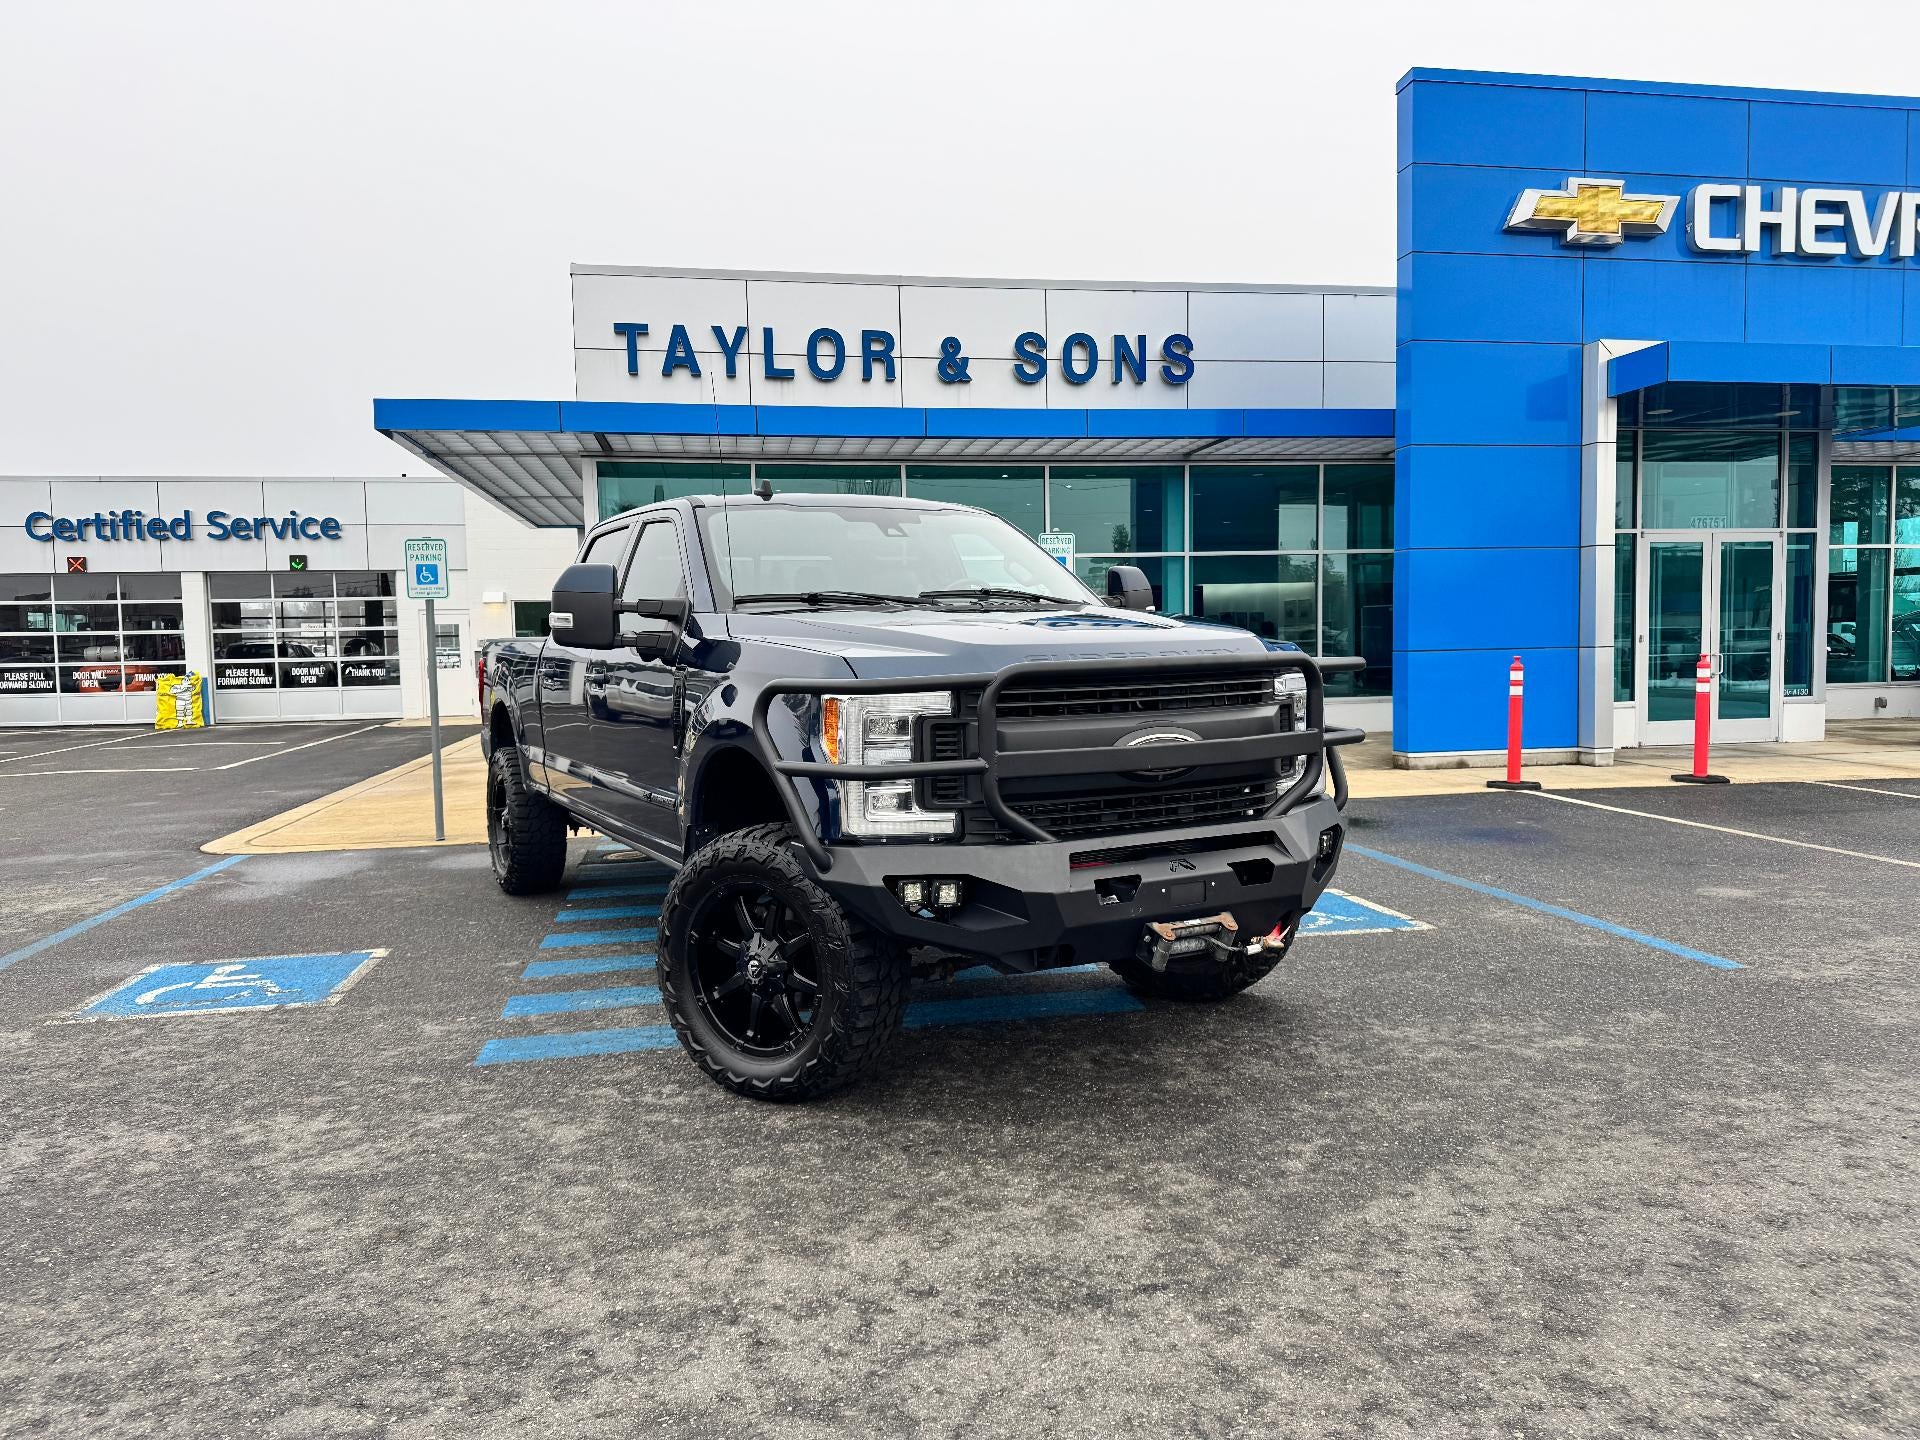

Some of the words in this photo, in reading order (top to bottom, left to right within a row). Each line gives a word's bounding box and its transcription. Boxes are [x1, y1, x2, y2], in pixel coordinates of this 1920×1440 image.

[613, 322, 897, 382] TAYLOR
[937, 336, 972, 384] &
[1012, 331, 1195, 385] SONS
[25, 509, 194, 542] Certified
[206, 510, 343, 541] Service
[1041, 537, 1072, 545] RESERVED
[407, 543, 444, 552] RESERVED
[410, 553, 442, 561] PARKING
[72, 671, 90, 680] DOOR
[226, 668, 249, 677] PLEASE
[250, 668, 265, 677] PULL
[291, 667, 309, 676] DOOR
[309, 666, 325, 675] WILL
[351, 668, 371, 677] THANK
[372, 668, 386, 676] YOU!
[4, 672, 29, 681] PLEASE
[29, 672, 45, 680] PULL
[135, 673, 156, 682] THANK
[217, 677, 248, 686] FORWARD
[248, 676, 273, 685] SLOWLY
[300, 675, 317, 684] OPEN
[0, 681, 28, 690] ORWARD
[28, 680, 53, 689] SLOWLY
[81, 679, 99, 688] OPEN
